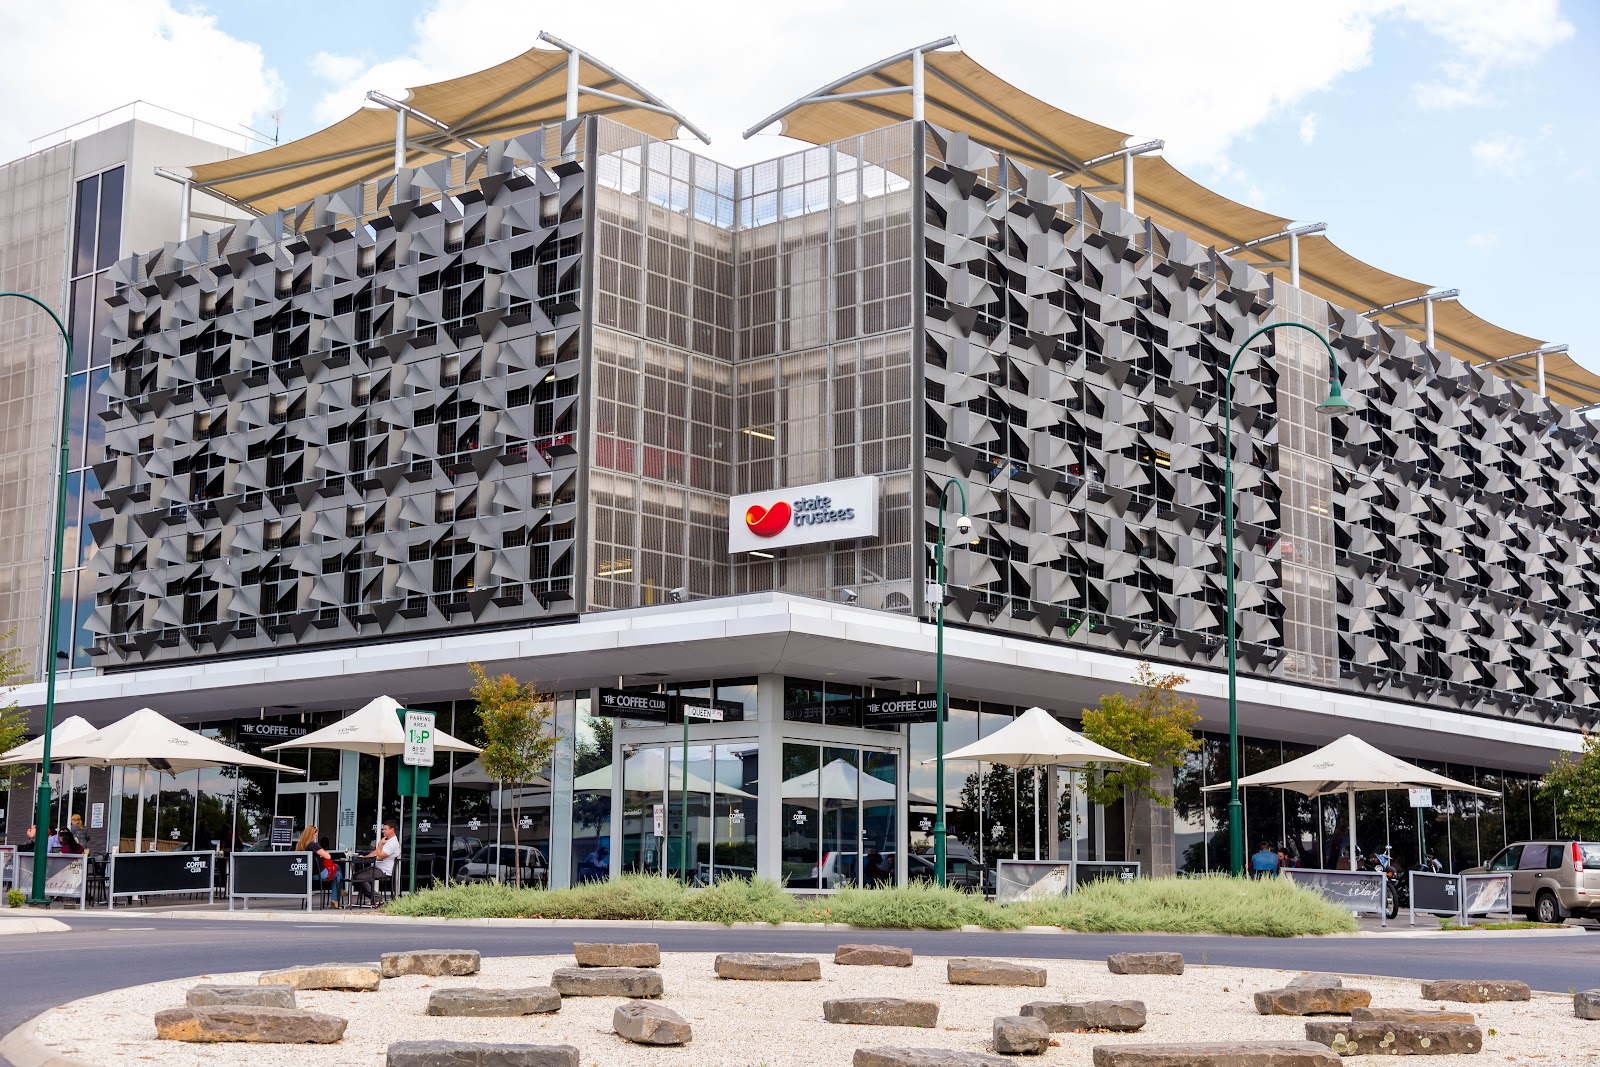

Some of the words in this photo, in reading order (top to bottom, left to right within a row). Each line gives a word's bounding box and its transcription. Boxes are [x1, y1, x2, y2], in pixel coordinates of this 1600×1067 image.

[793, 495, 831, 512] state
[794, 508, 855, 526] trustees
[603, 695, 616, 705] THE
[617, 695, 648, 708] COFFEE
[649, 699, 665, 709] CLUB
[867, 704, 880, 712] THE
[881, 700, 916, 712] COFFEE
[918, 700, 937, 709] CLUB
[692, 708, 711, 717] QUEEN
[242, 724, 255, 732] THE
[256, 724, 288, 735] COFFEE
